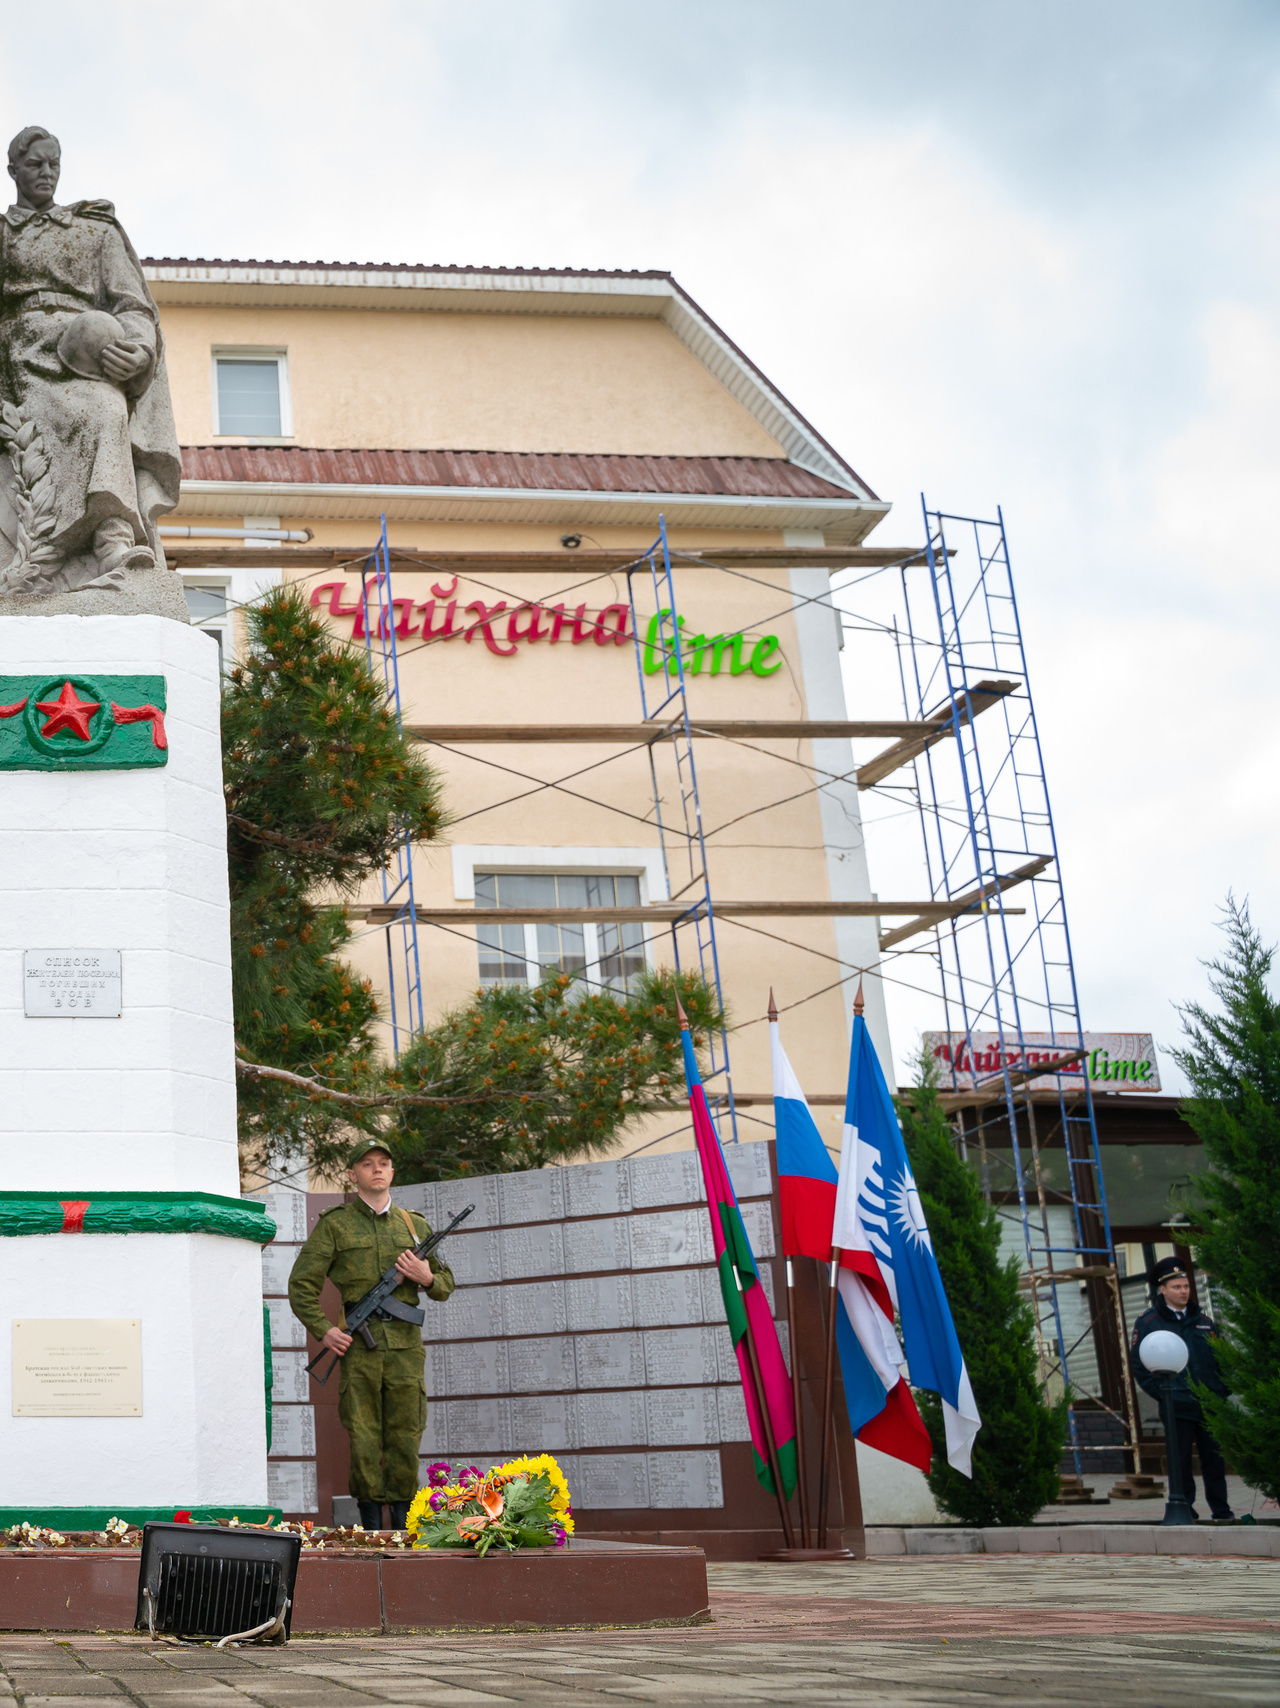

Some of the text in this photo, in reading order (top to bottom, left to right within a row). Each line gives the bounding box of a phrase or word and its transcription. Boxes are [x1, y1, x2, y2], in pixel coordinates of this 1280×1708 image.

[310, 574, 638, 657] Чайхана
[45, 957, 100, 967] СПИСОК
[1088, 1048, 1153, 1081] lime
